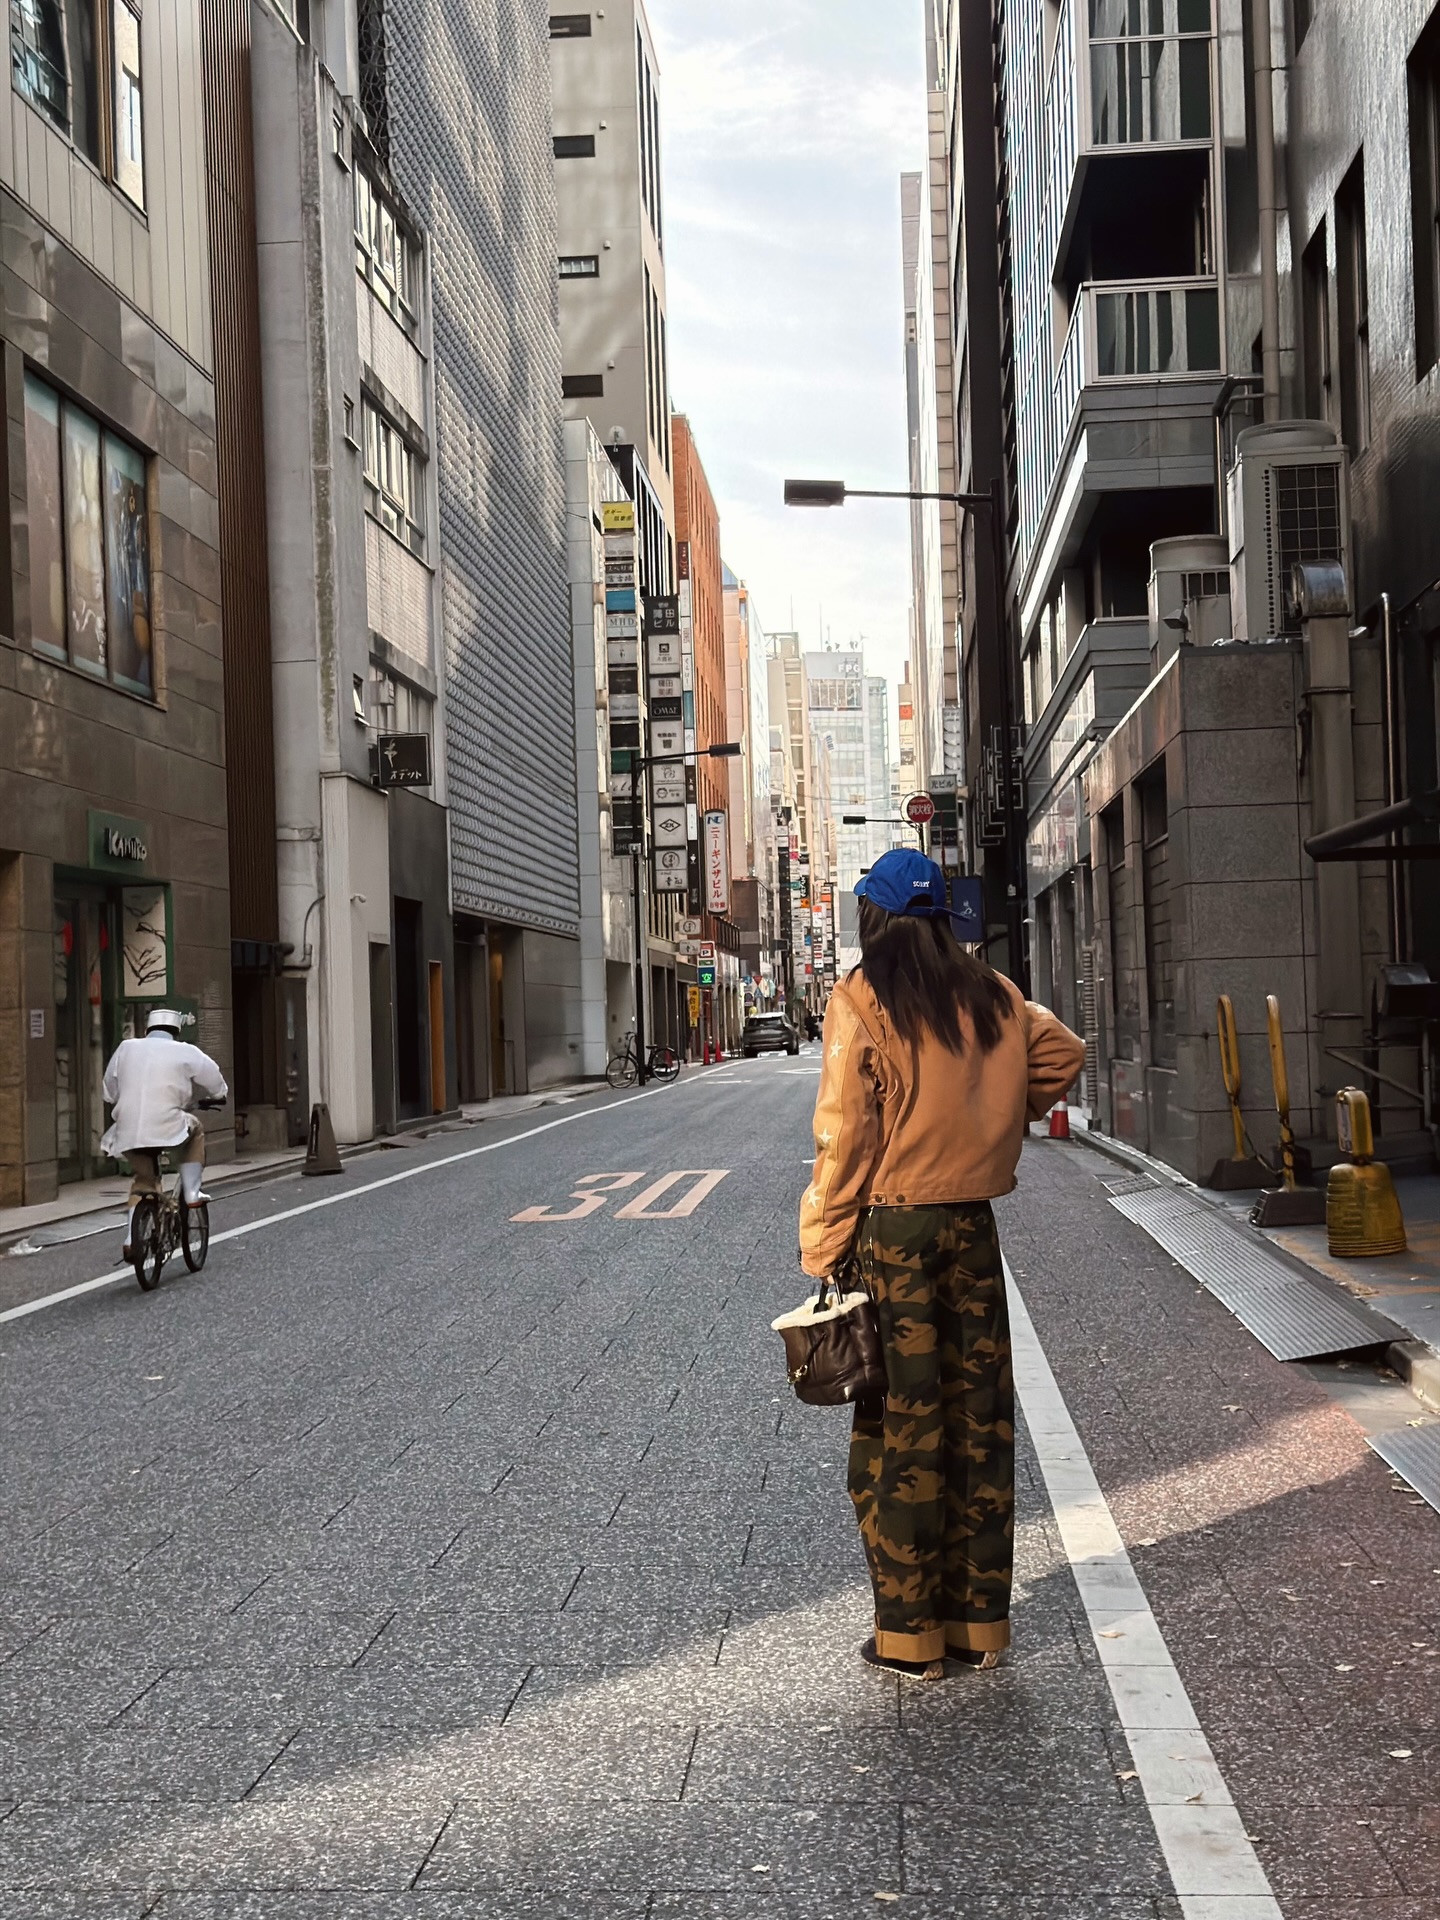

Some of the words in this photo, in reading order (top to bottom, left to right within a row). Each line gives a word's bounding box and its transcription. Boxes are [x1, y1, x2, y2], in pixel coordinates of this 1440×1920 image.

[838, 663, 861, 673] FPG
[710, 827, 722, 898] ニューギンザビル
[508, 1169, 731, 1223] 30
